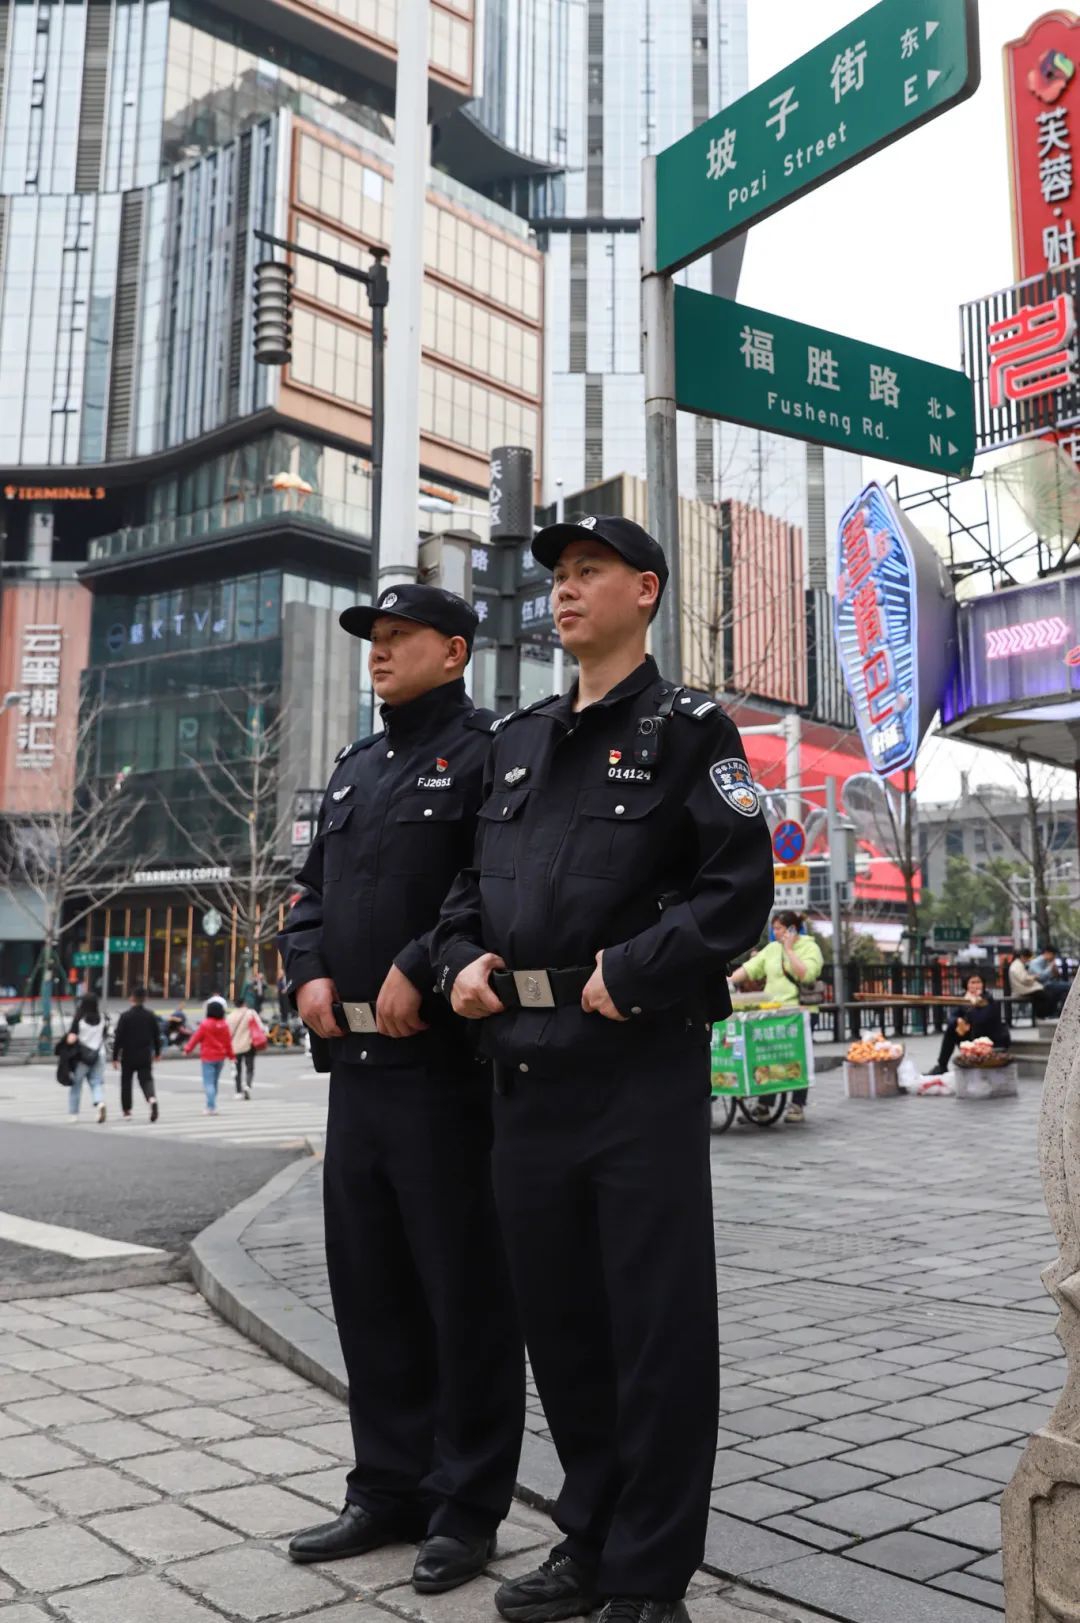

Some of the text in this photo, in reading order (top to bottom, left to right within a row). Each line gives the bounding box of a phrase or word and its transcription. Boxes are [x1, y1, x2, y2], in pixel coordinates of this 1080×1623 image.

[899, 27, 921, 60] 东
[903, 75, 919, 107] E
[705, 39, 869, 182] 坡子街
[727, 122, 848, 212] Pozi Street
[739, 325, 901, 409] 福胜路
[767, 392, 891, 441] Fusheng Rd.
[927, 396, 944, 420] 北
[928, 434, 943, 457] N
[417, 777, 451, 788] FJ2651
[607, 767, 652, 780] 014124
